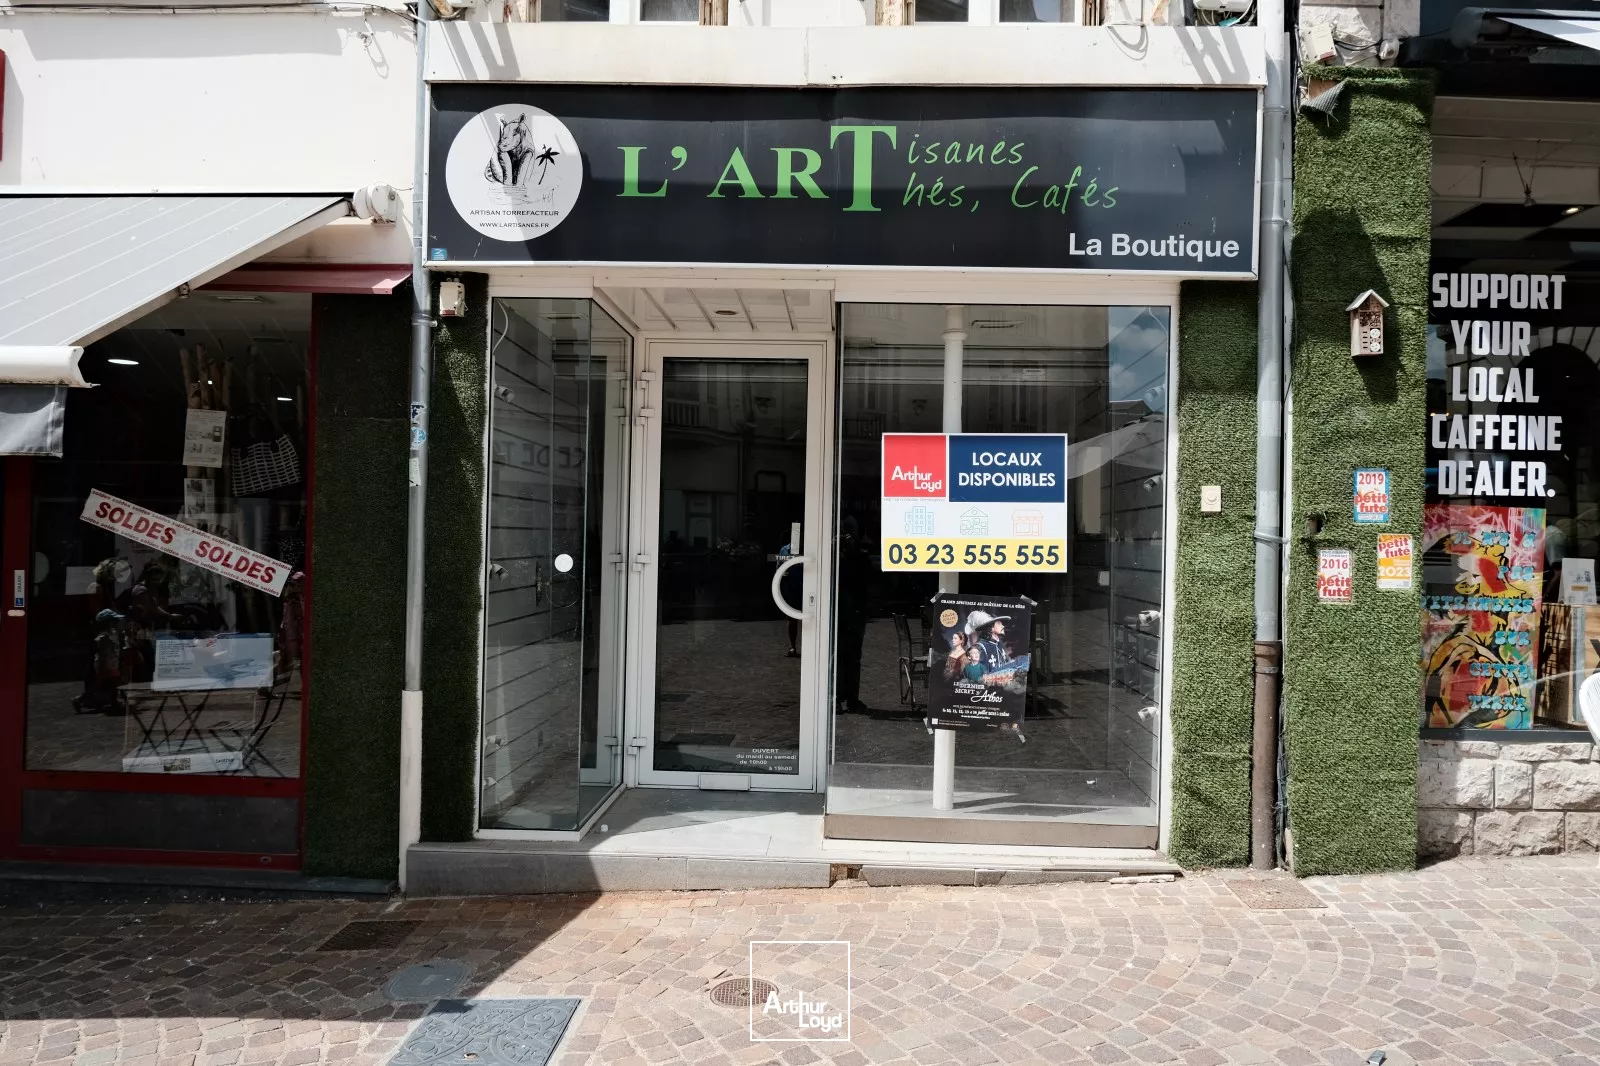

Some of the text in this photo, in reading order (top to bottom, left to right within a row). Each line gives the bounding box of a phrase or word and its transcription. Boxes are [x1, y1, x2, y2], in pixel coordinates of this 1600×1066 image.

[1010, 166, 1120, 214] Cafés
[1069, 233, 1240, 262] La Boutique
[1432, 273, 1566, 310] SUPPORT
[1450, 320, 1531, 356] YOUR
[1452, 367, 1540, 403] LOCAL
[1431, 414, 1563, 451] CAFFEINE
[972, 452, 1042, 466] LOCAUX
[891, 466, 933, 481] Arthur
[958, 472, 1056, 487] DISPONIBLES
[1358, 473, 1384, 485] 2019
[1438, 460, 1556, 497] DEALER.
[914, 479, 942, 493] Loyd
[1354, 491, 1388, 505] petit
[95, 501, 276, 583] SOLDES SOLDES
[1378, 537, 1409, 552] petit
[889, 543, 1060, 565] 03 23 555 555
[1321, 558, 1348, 569] 2016
[1318, 575, 1352, 589] petit
